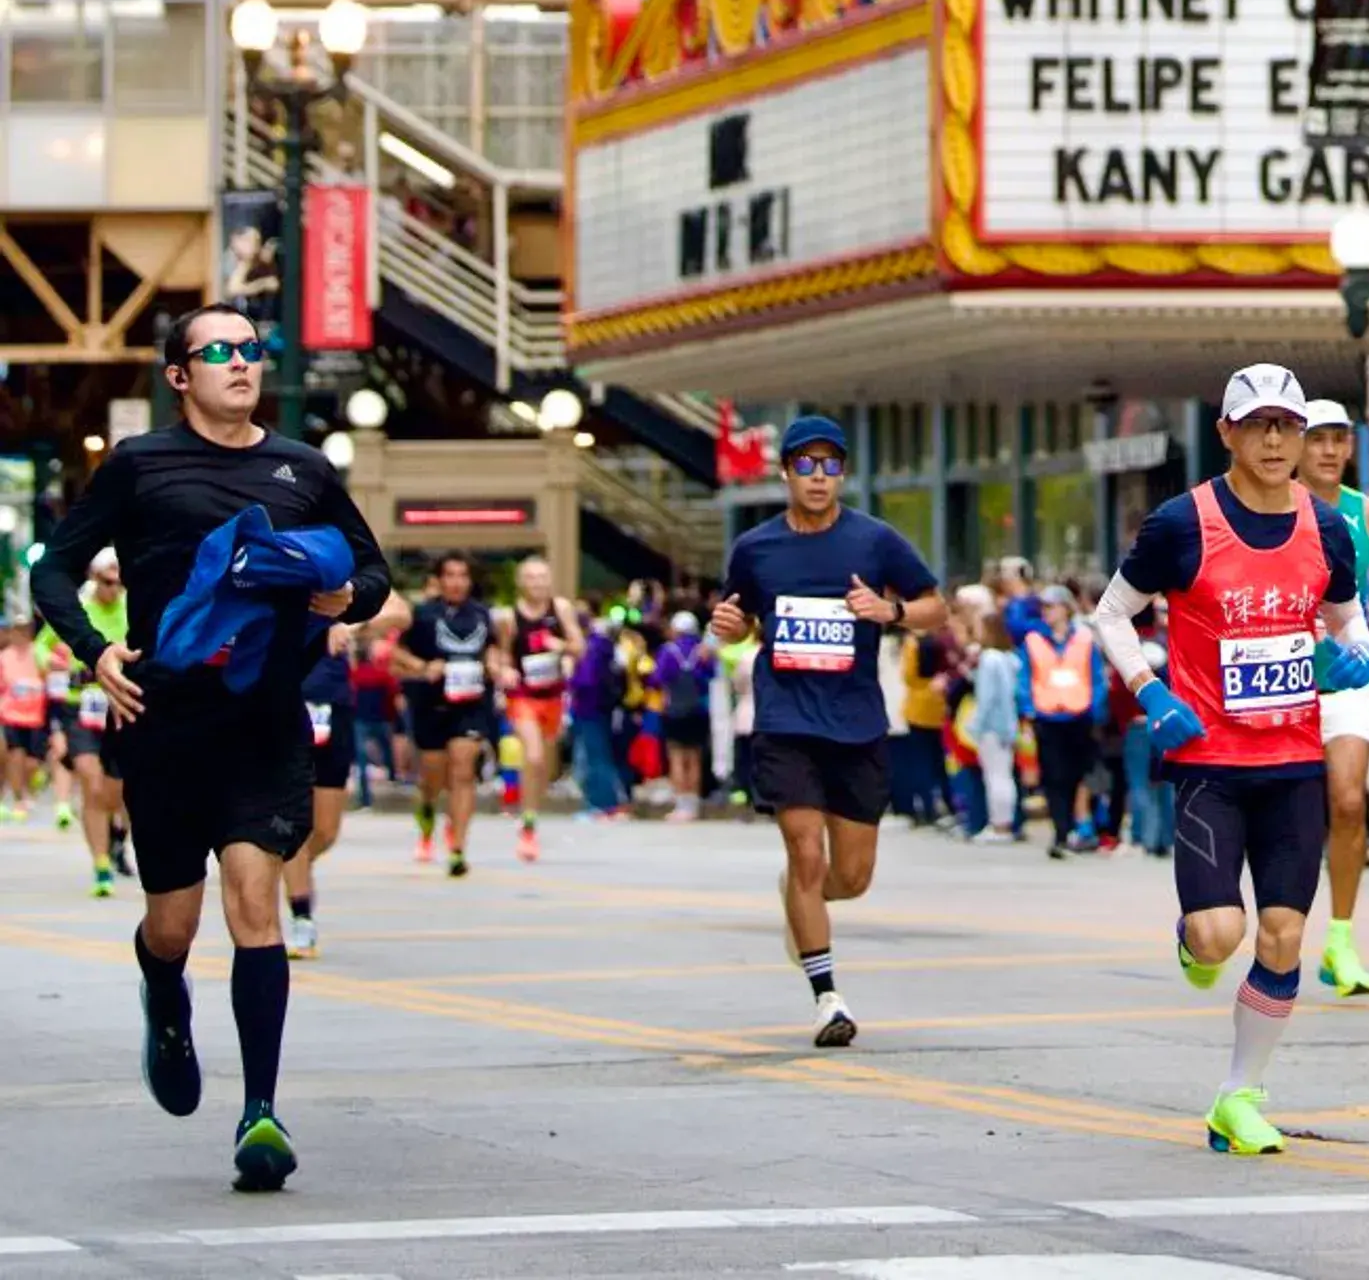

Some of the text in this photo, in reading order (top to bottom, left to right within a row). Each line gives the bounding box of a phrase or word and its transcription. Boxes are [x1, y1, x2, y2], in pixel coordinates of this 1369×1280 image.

[1031, 56, 1222, 113] FELIPE
[1056, 146, 1222, 205] KANY
[775, 619, 854, 643] A 21089
[1224, 658, 1314, 696] B 4280
